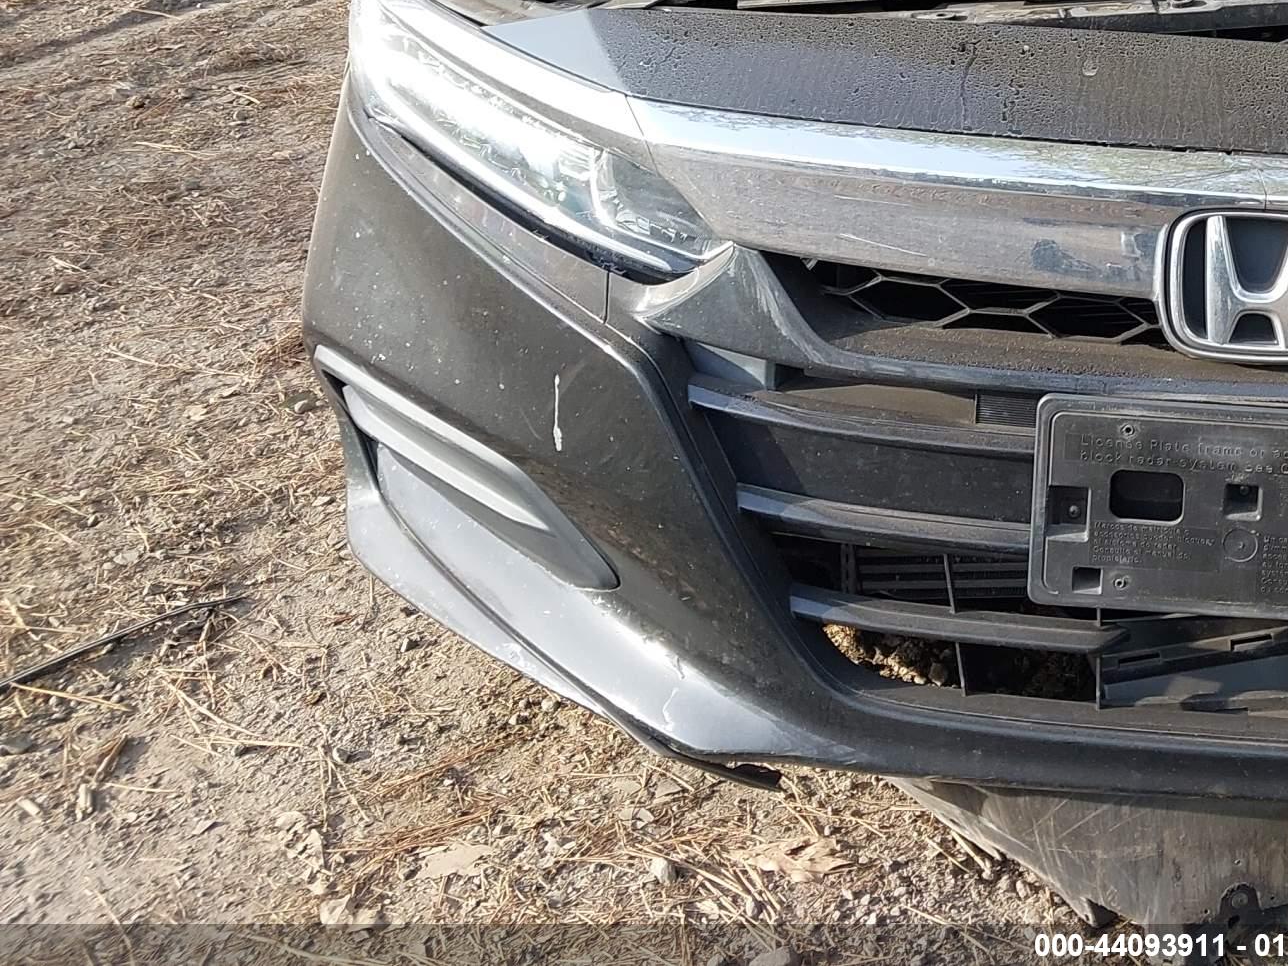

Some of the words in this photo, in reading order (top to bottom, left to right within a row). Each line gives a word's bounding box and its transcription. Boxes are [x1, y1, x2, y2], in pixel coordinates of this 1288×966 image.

[1081, 434, 1144, 450] License
[1150, 439, 1190, 453] Plate
[1249, 448, 1265, 459] or
[1129, 455, 1172, 467] radar
